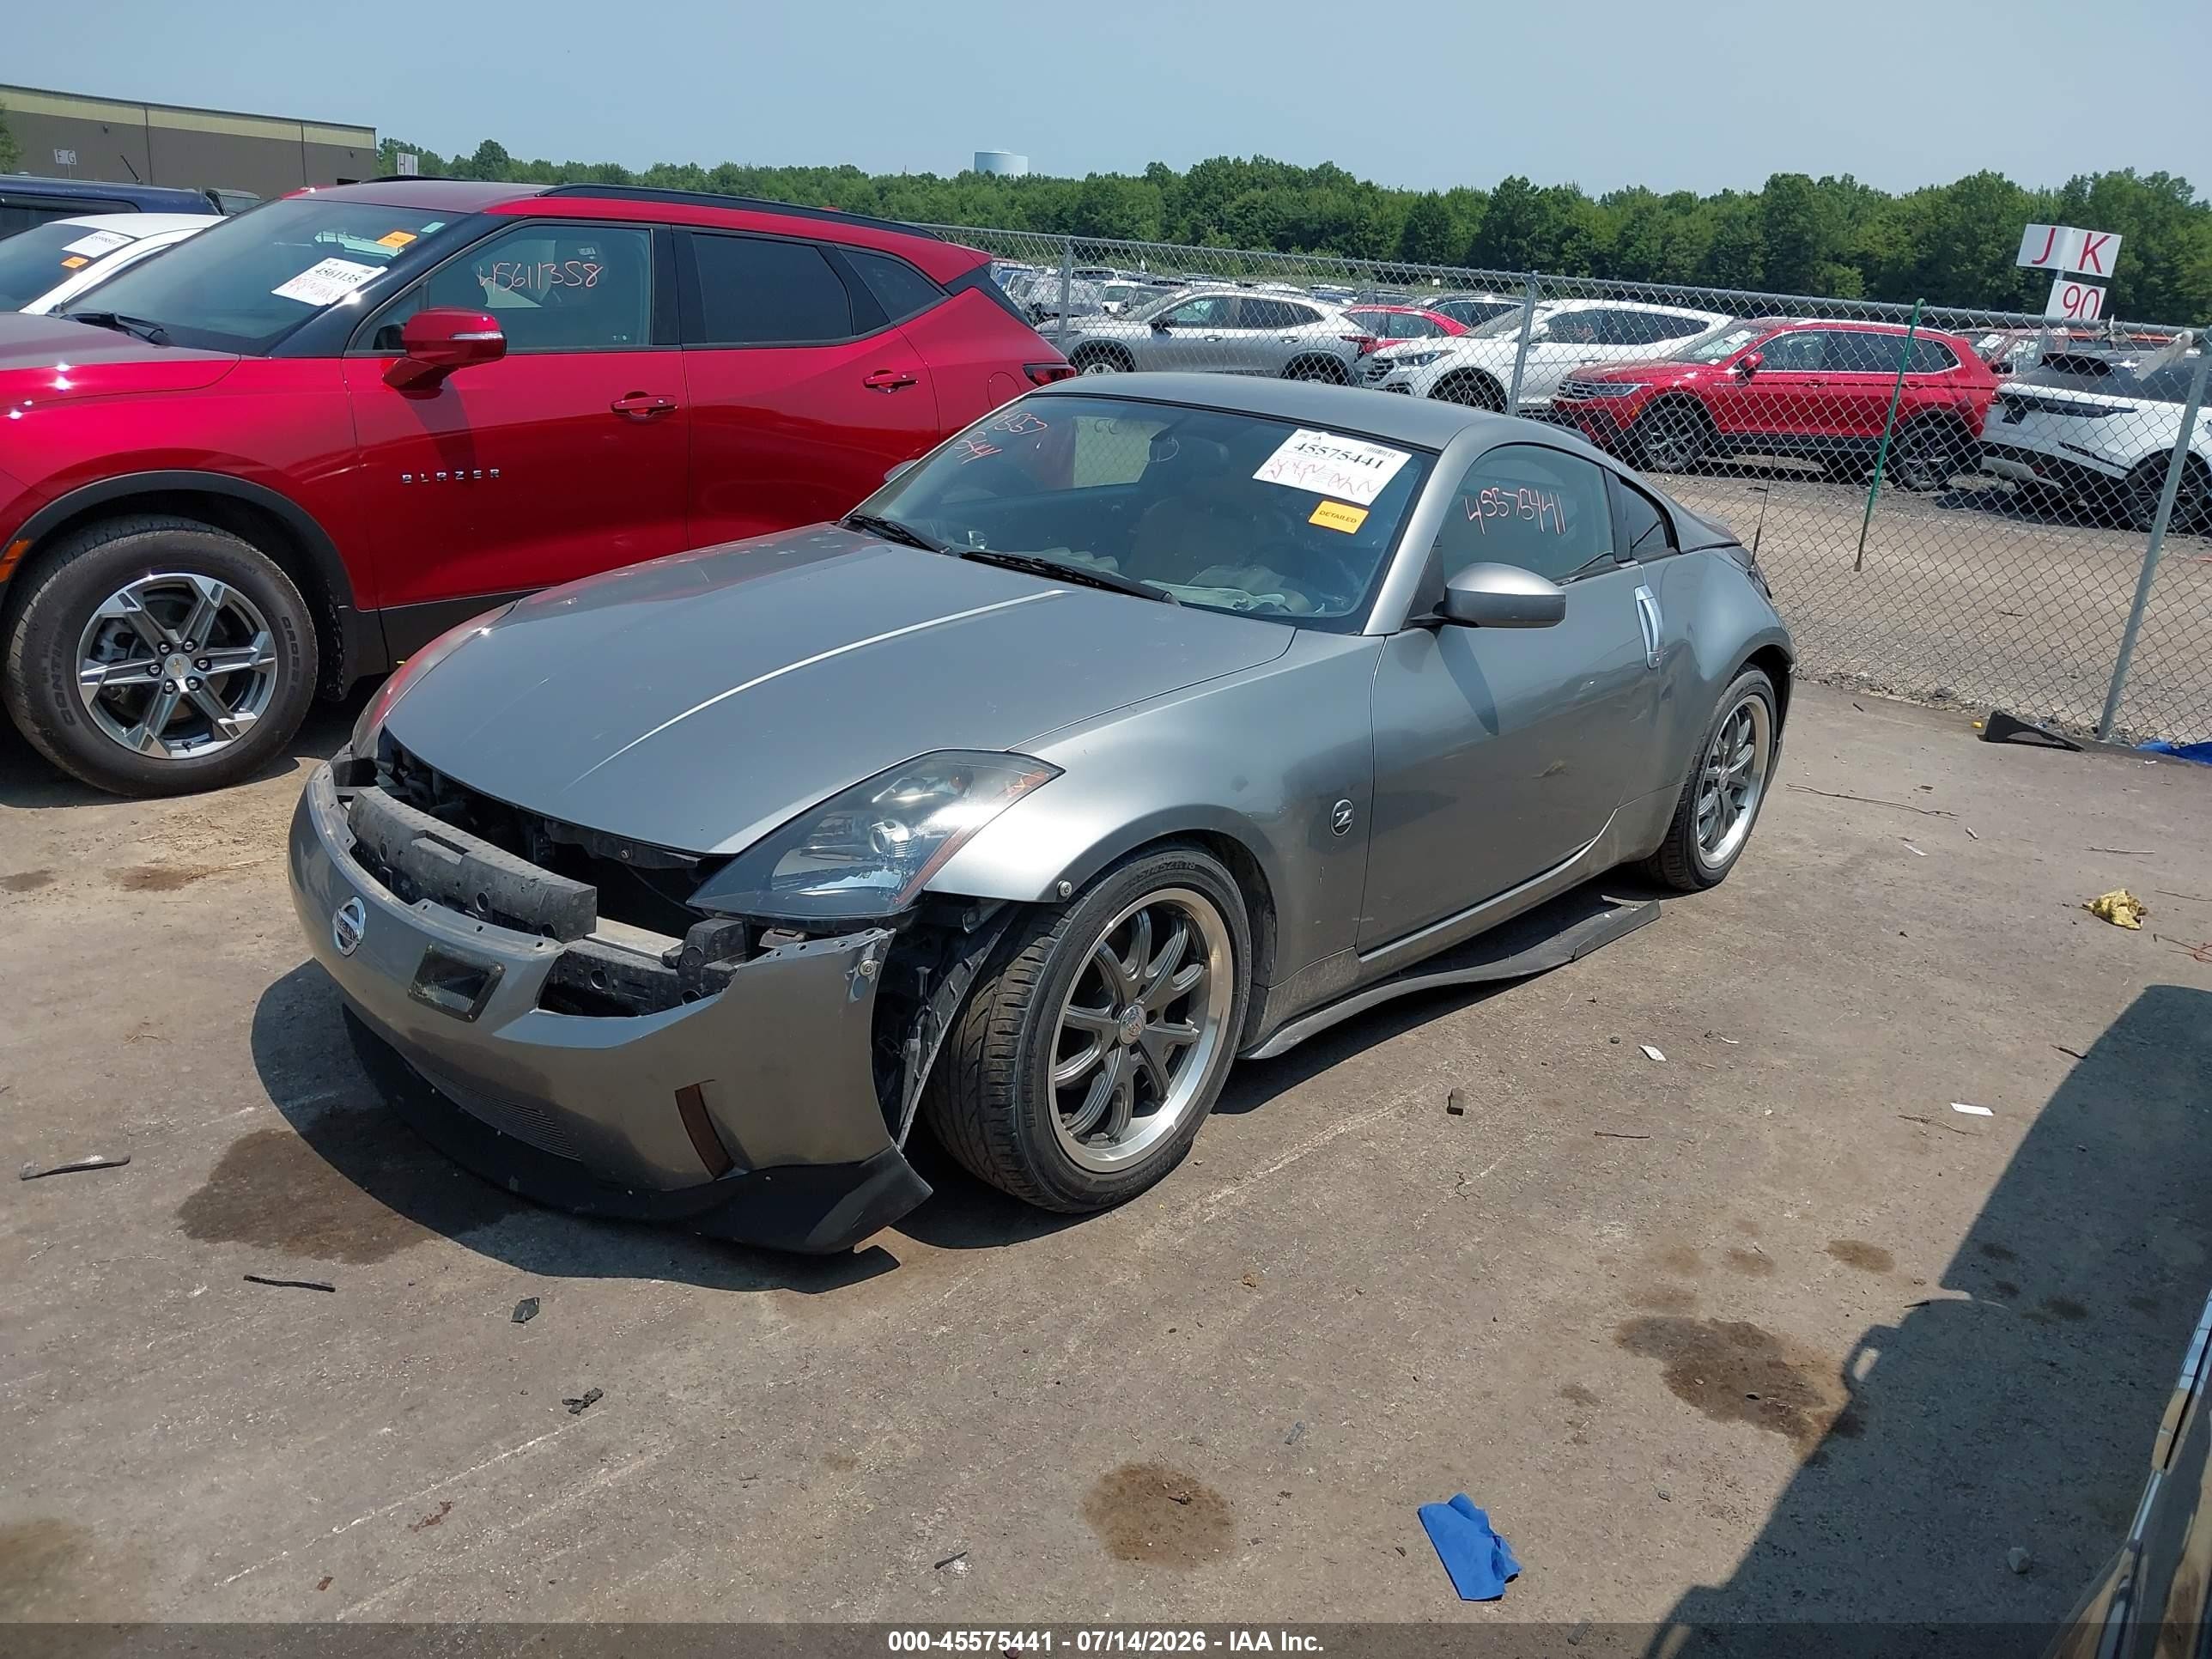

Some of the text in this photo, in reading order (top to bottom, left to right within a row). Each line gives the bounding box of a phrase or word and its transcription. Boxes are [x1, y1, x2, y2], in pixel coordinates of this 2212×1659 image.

[56, 149, 76, 164] F G
[398, 154, 406, 174] H
[2032, 228, 2111, 274] J K
[314, 268, 364, 283] 4561135
[477, 260, 605, 295] 45611358
[2063, 285, 2100, 319] 90
[1293, 442, 1385, 470] 45575441
[402, 468, 500, 483] BLAZER
[1318, 508, 1358, 525] DETAILED
[1464, 487, 1566, 536] 45575441
